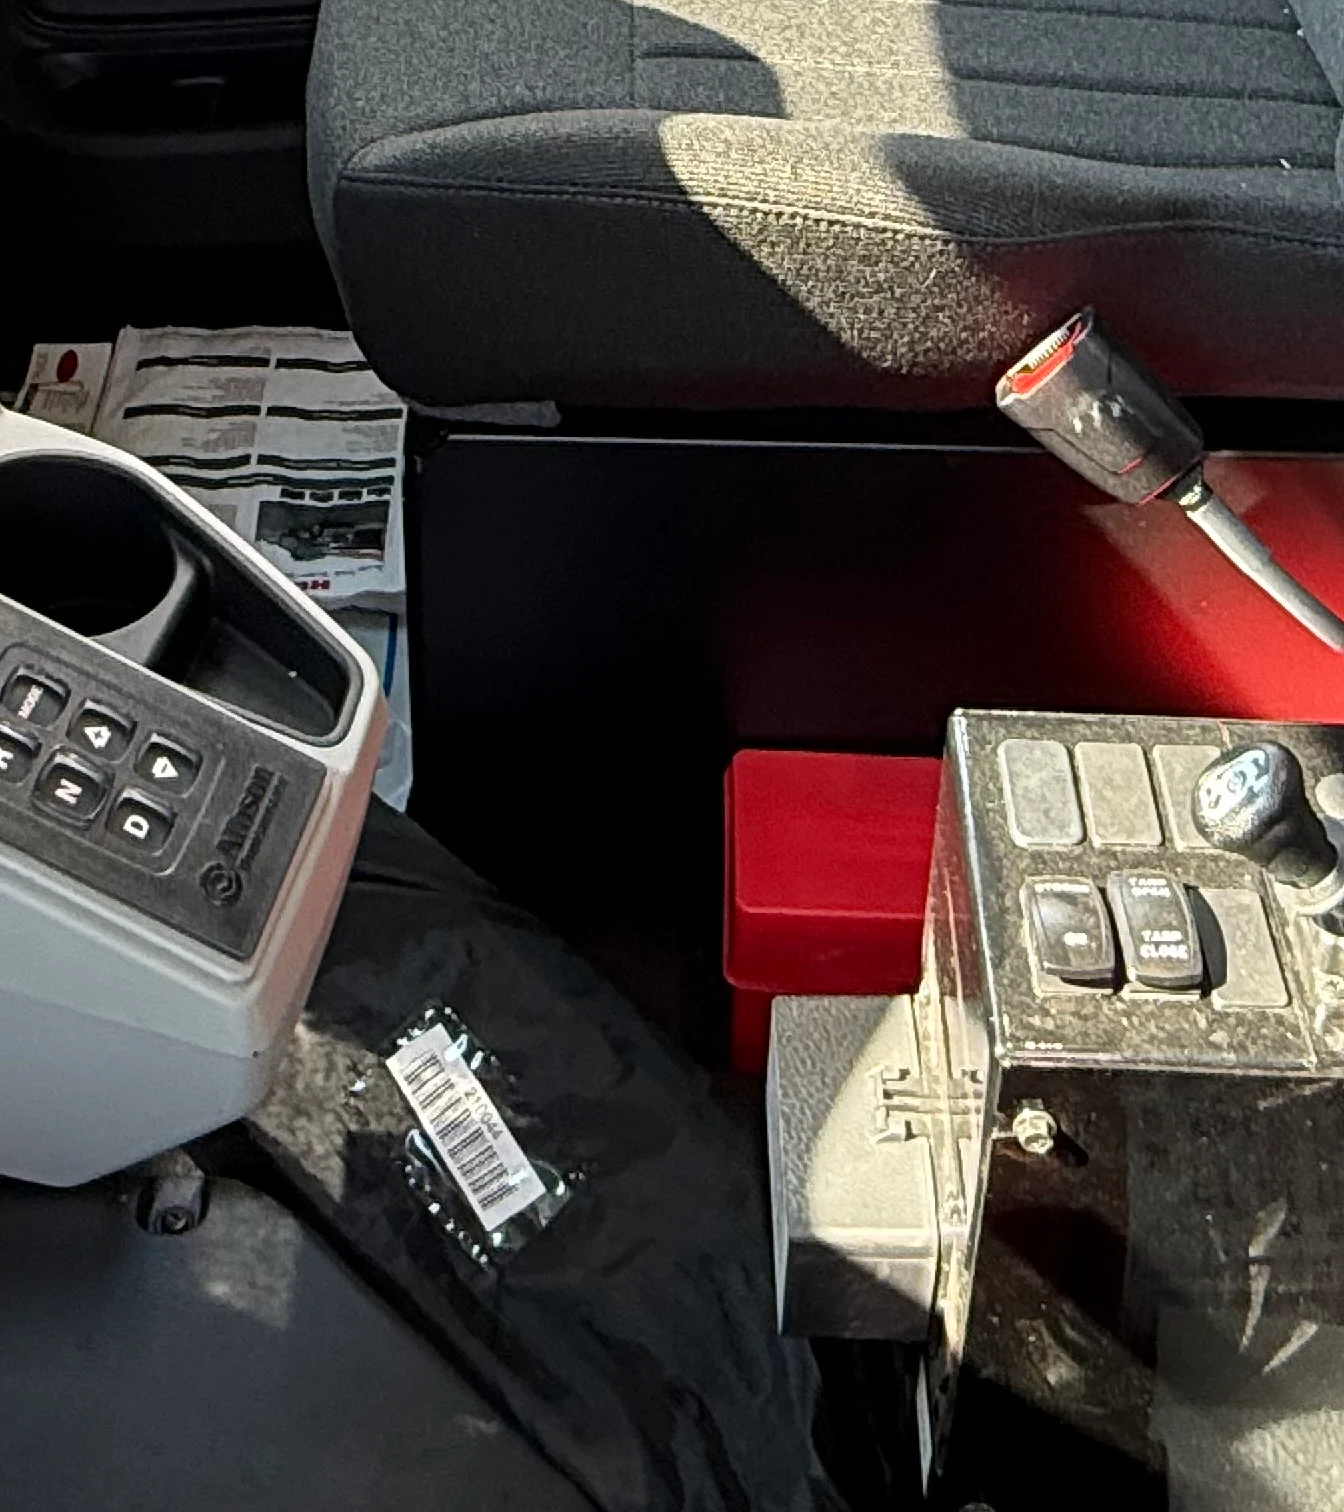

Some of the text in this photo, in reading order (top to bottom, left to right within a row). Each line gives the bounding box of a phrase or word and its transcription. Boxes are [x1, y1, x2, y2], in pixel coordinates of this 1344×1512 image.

[18, 684, 45, 720] MODE
[54, 778, 83, 805] N
[122, 814, 150, 840] D
